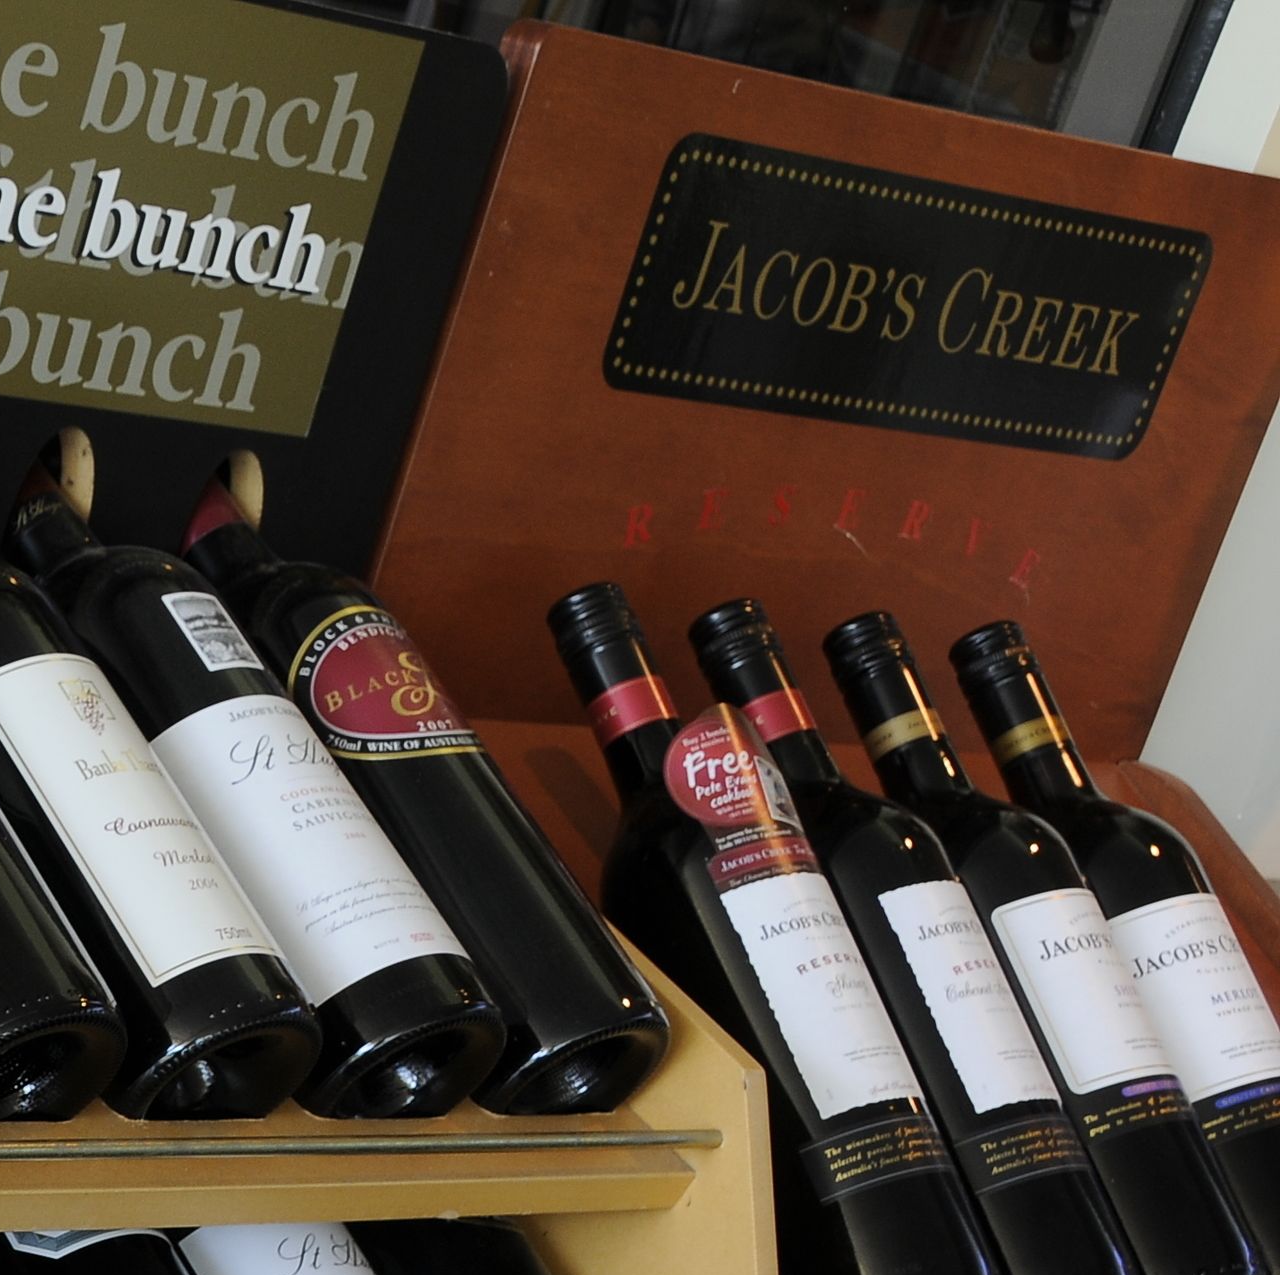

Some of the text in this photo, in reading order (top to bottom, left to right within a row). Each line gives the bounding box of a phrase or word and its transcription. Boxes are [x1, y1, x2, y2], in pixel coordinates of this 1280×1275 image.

[80, 22, 375, 181] bunch
[82, 167, 327, 294] bunch
[672, 218, 1141, 378] JACOB'S CREEK
[622, 483, 1042, 589] RESERVE
[299, 620, 349, 678] BLOCK
[324, 669, 418, 712] BLACK
[416, 719, 454, 732] 2007
[229, 733, 277, 786] St
[366, 741, 401, 753] WINE
[683, 750, 754, 789] Free
[189, 878, 218, 891] 2004
[759, 916, 822, 941] JACOB'S
[918, 918, 970, 941] JACOB'S
[1039, 933, 1114, 961] JACOB'S
[1132, 938, 1219, 980] JACOB'S
[824, 1147, 842, 1158] The
